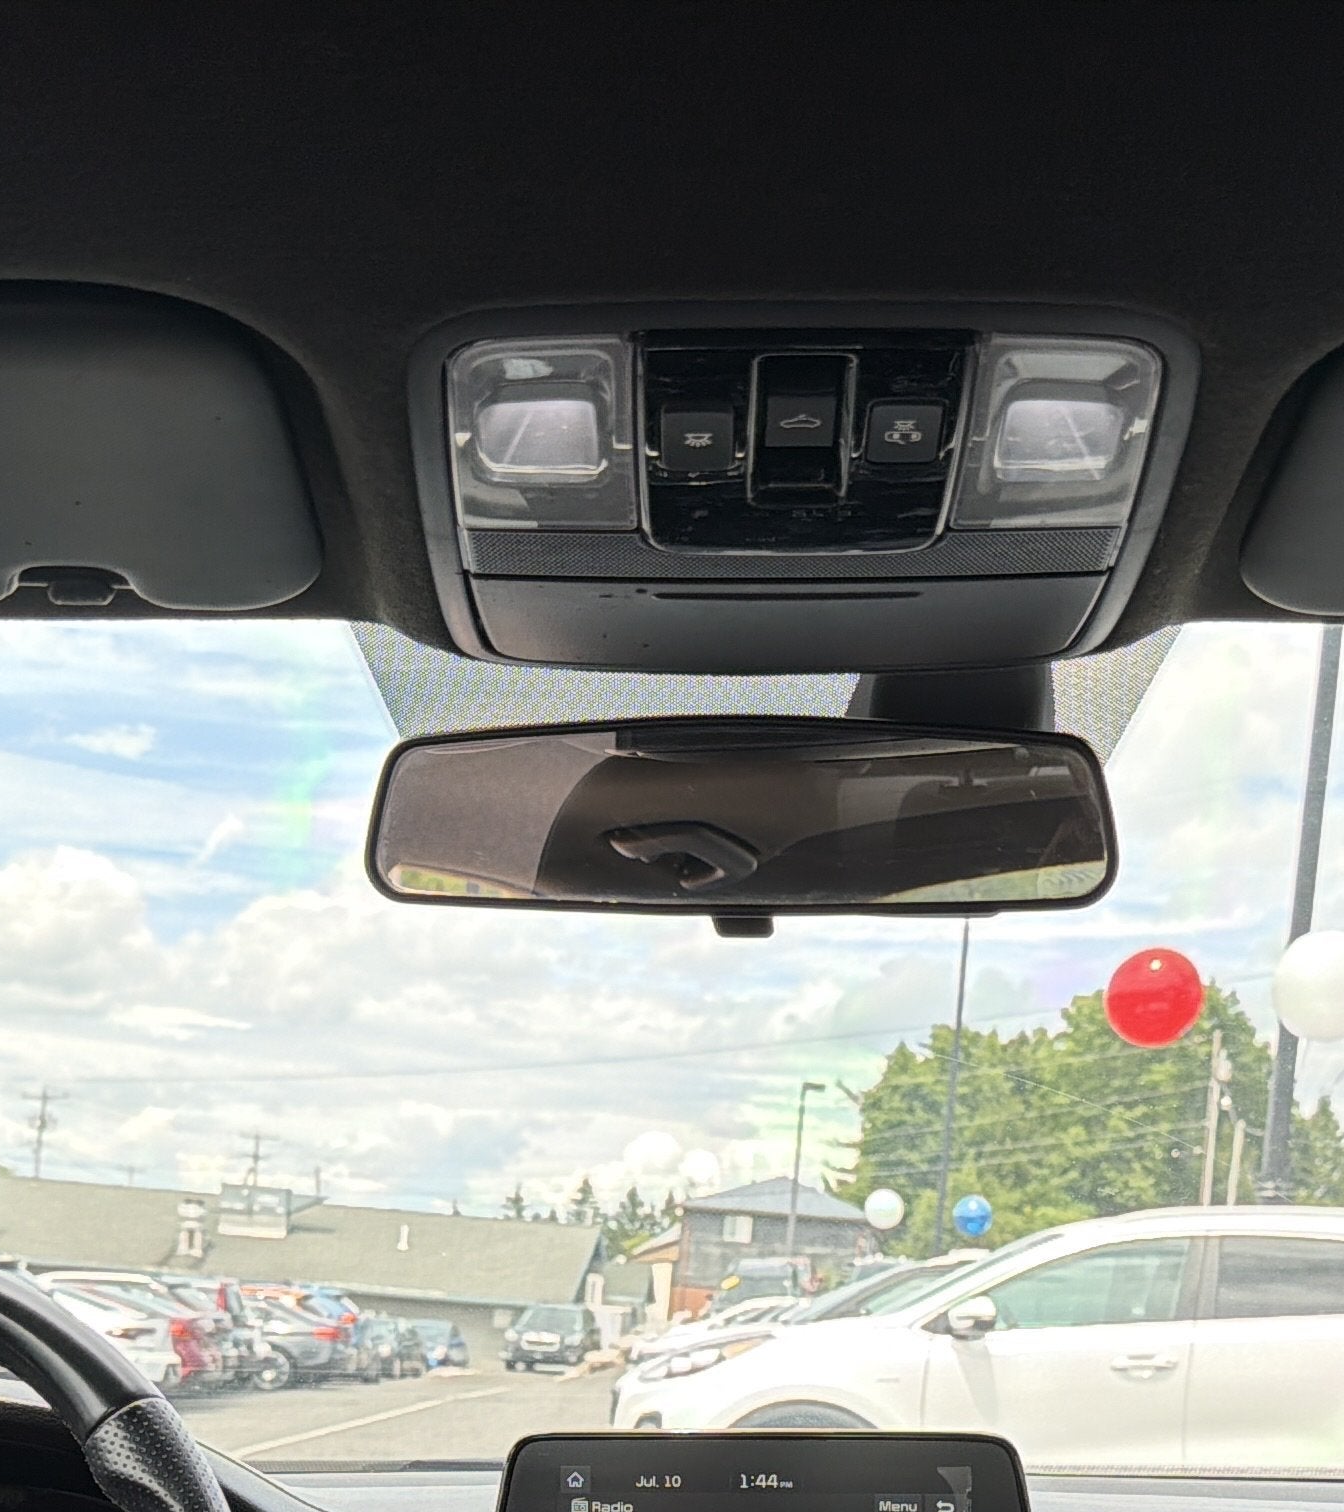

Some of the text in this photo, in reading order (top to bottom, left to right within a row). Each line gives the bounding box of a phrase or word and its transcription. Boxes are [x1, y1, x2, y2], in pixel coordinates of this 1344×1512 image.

[635, 1475, 682, 1488] Jul. 10
[740, 1473, 778, 1489] 1:44
[878, 1500, 918, 1512] Menu
